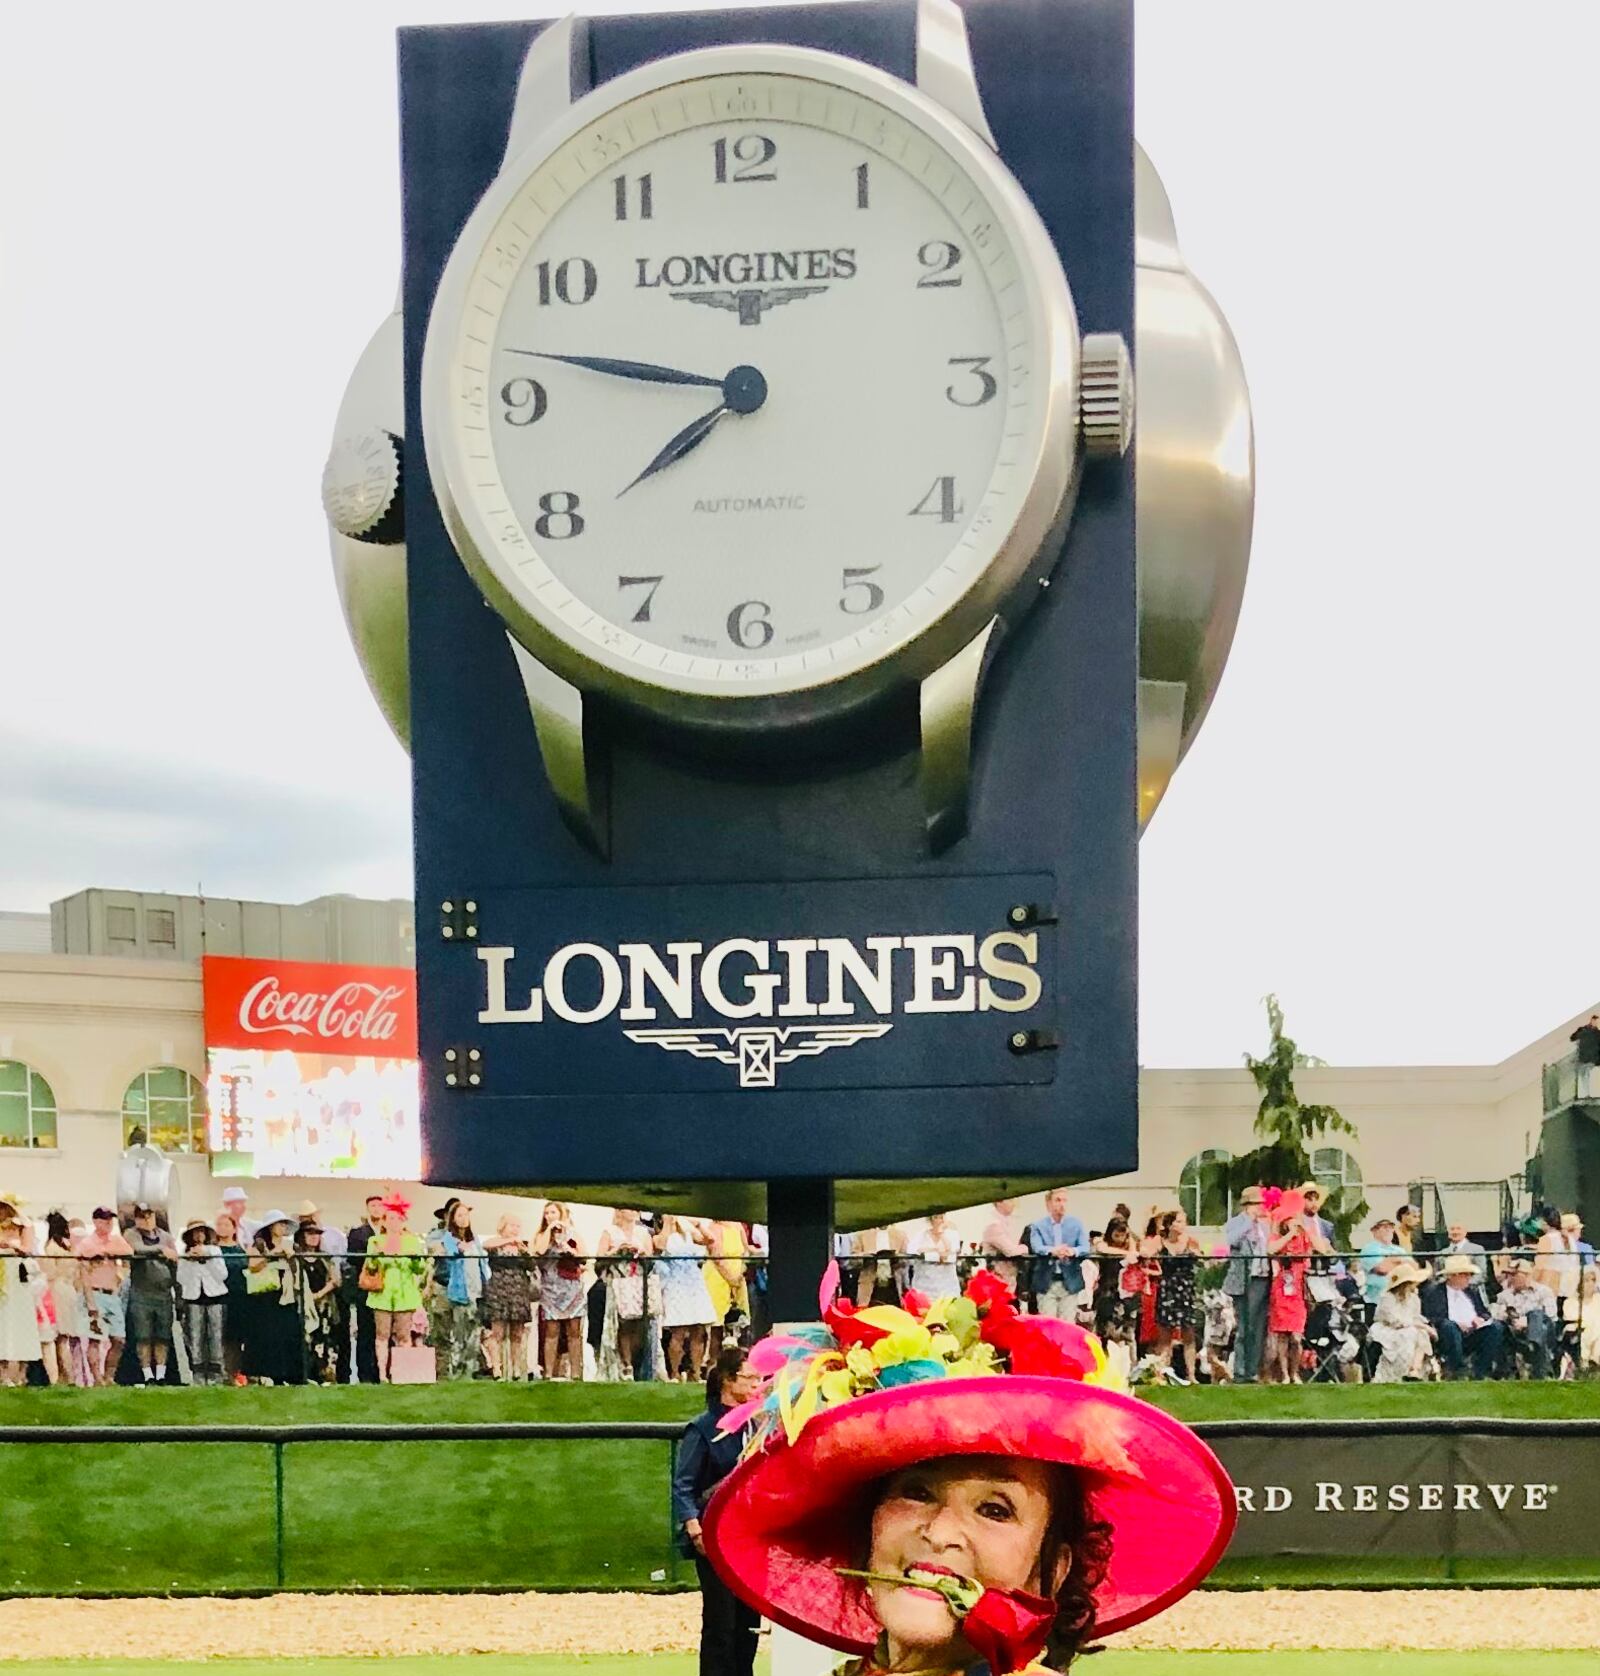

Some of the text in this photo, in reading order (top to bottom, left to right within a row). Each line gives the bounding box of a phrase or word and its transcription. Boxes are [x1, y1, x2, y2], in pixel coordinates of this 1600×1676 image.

[711, 134, 777, 183] 12
[611, 172, 654, 221] 11
[852, 162, 870, 209] 1
[535, 256, 598, 306] 10
[635, 248, 858, 288] LONGINES
[916, 239, 963, 289] 2
[500, 377, 548, 426] 9
[946, 356, 997, 408] 3
[535, 491, 585, 540] 8
[692, 496, 807, 513] AUTOMATIC
[906, 475, 964, 524] 4
[618, 574, 664, 622] 7
[839, 562, 885, 615] 5
[726, 600, 774, 650] 6
[476, 930, 1044, 1025] LONGINES
[239, 976, 406, 1040] Coca-Cola
